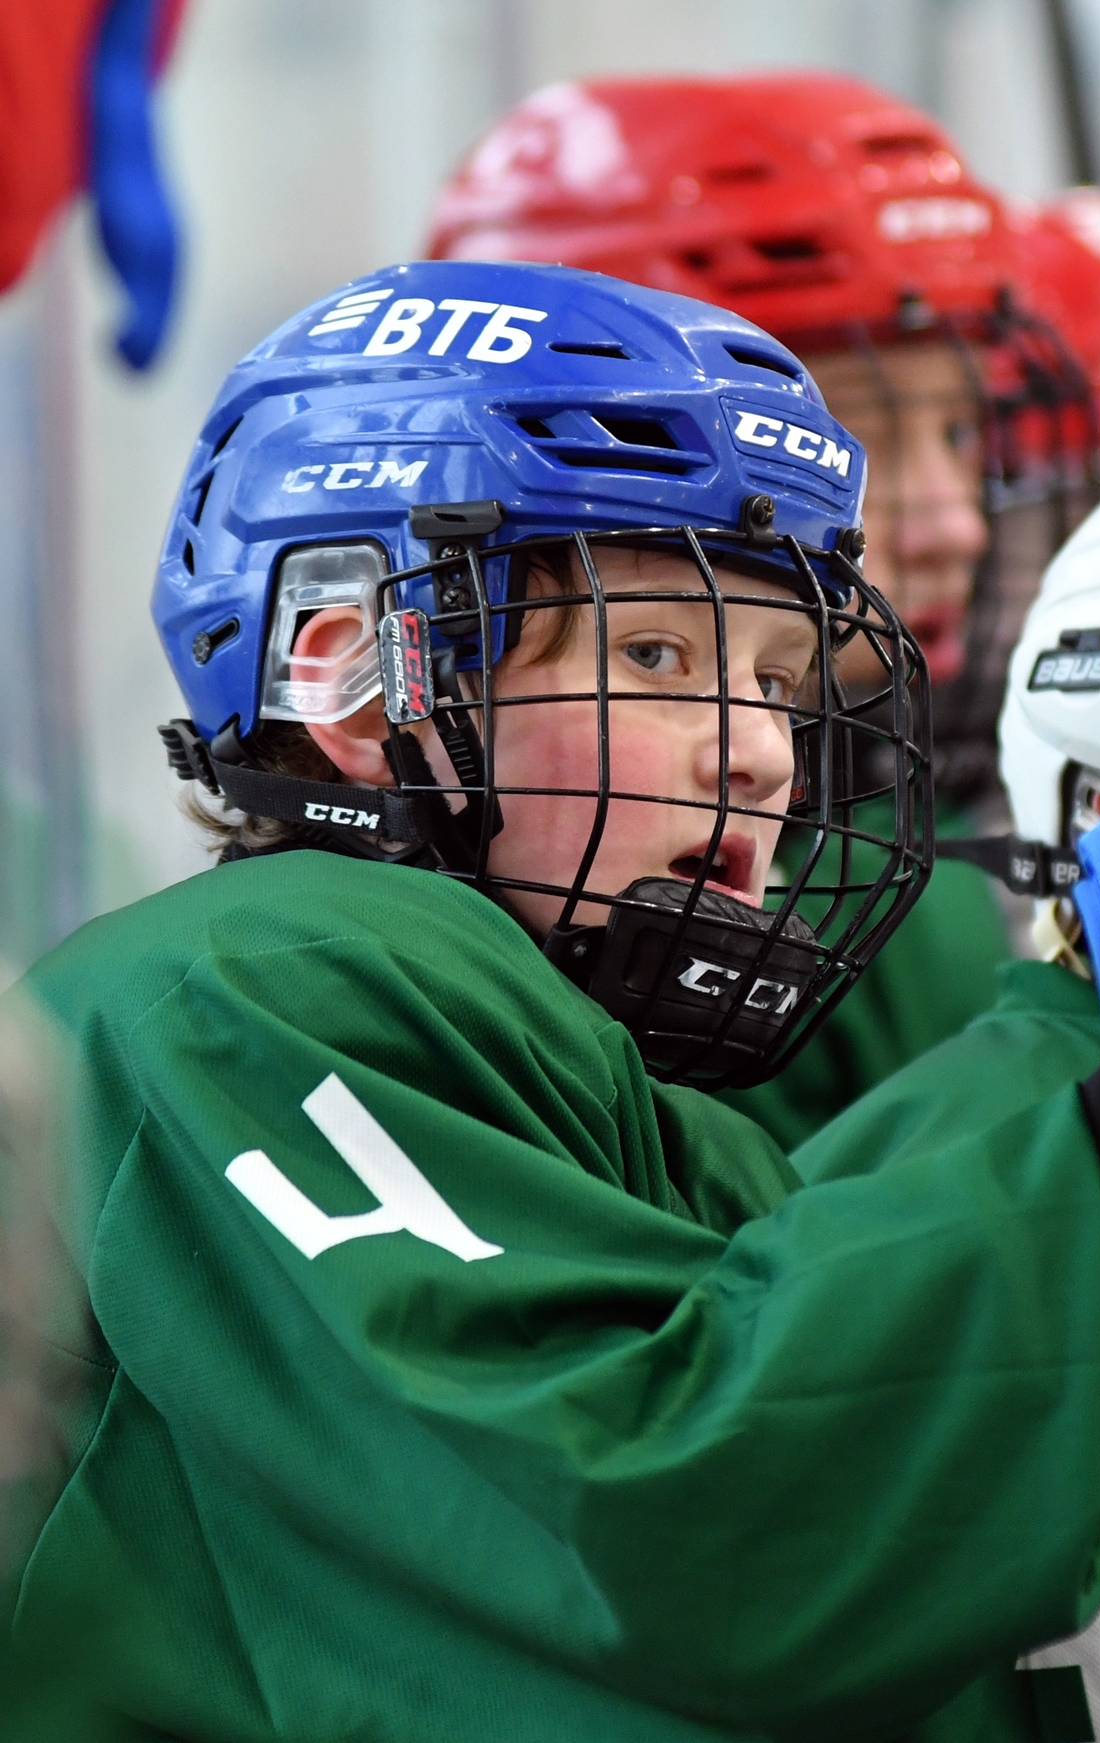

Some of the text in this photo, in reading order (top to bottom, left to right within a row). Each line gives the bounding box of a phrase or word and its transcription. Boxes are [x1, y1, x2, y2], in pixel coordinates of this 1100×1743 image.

[362, 297, 548, 364] ВТБ
[282, 460, 429, 494] CCM
[734, 410, 852, 477] CCM
[402, 612, 425, 713] CCM
[304, 802, 380, 830] CCM
